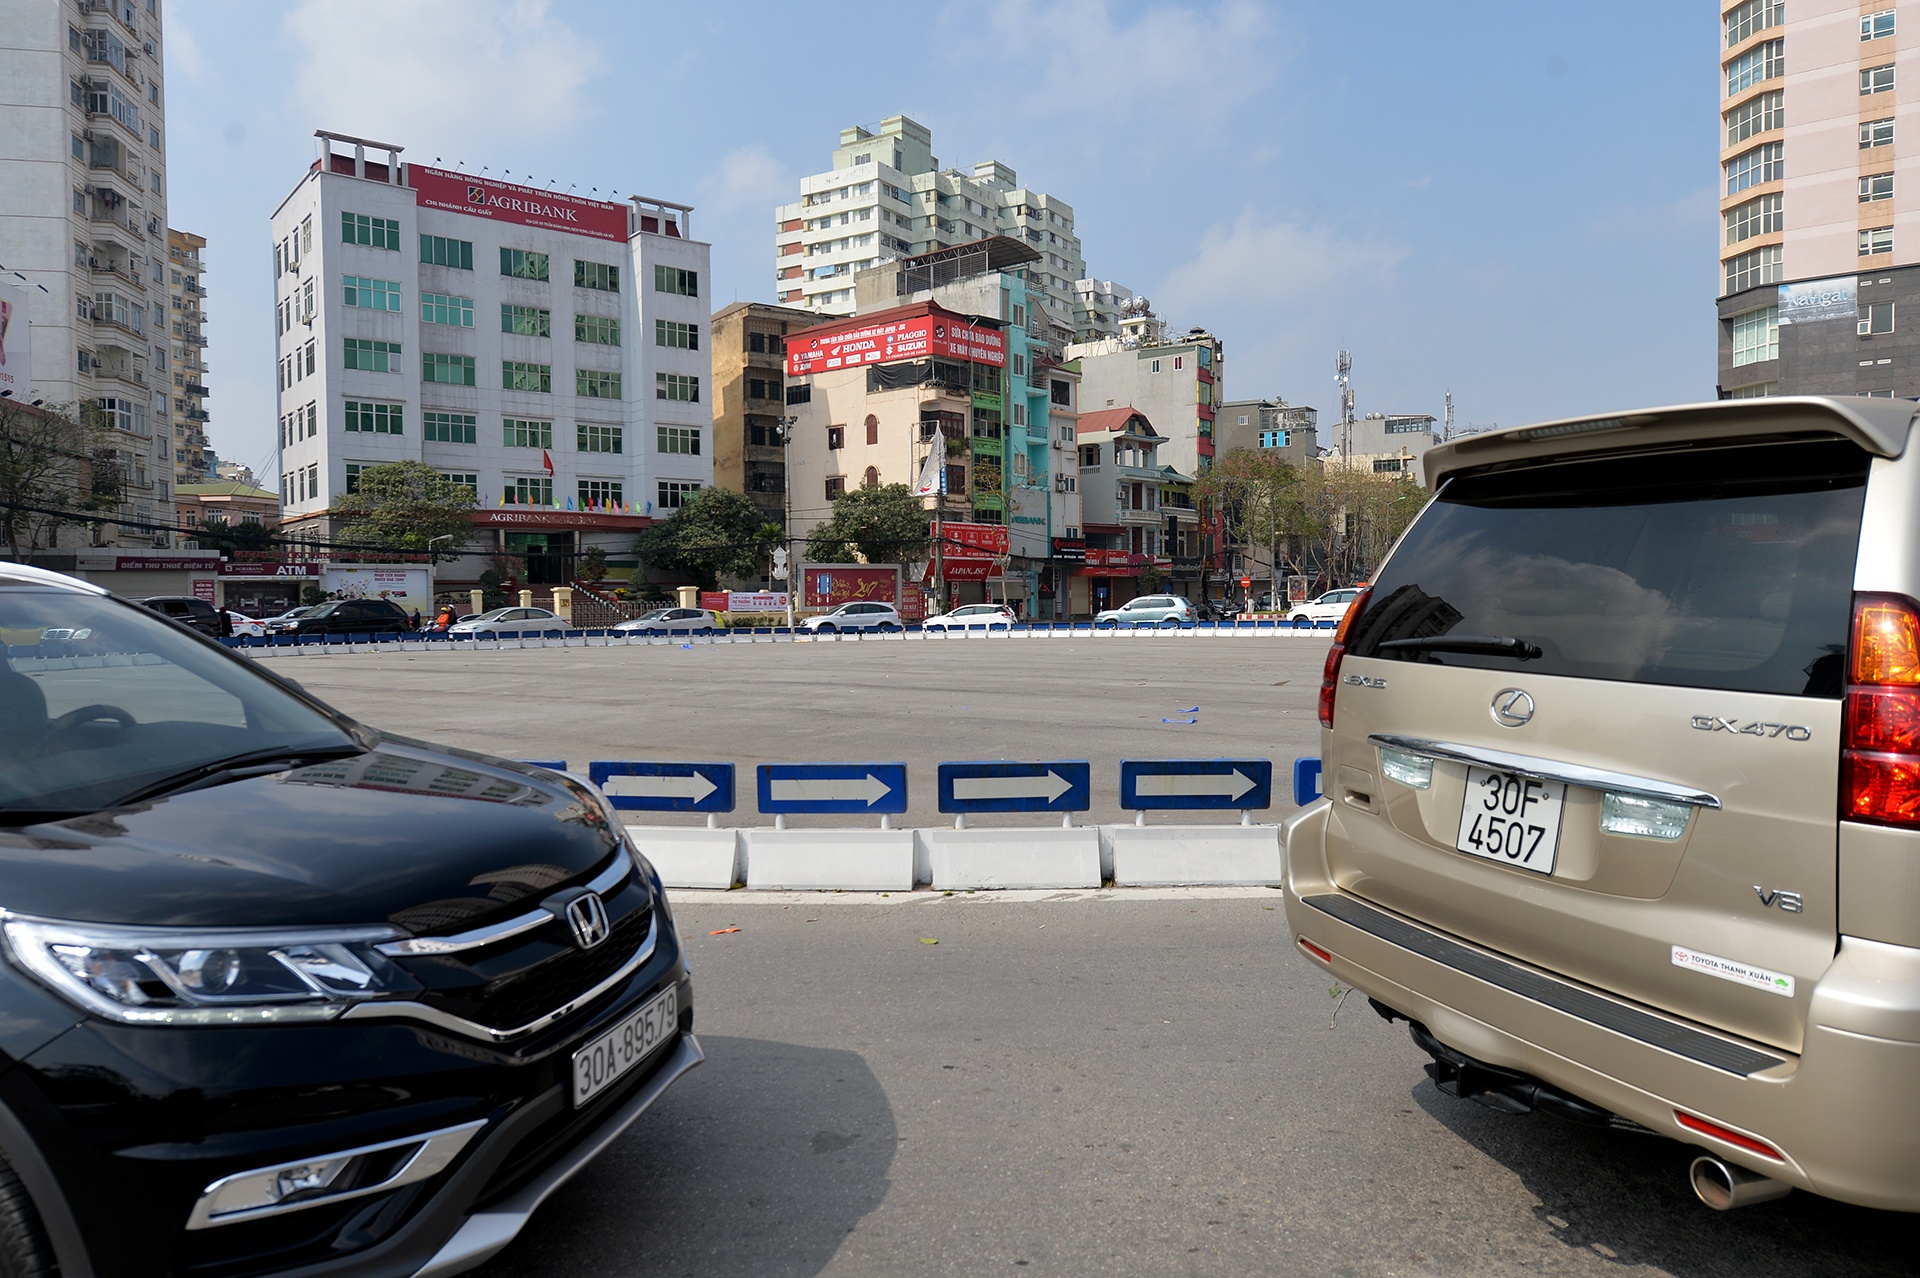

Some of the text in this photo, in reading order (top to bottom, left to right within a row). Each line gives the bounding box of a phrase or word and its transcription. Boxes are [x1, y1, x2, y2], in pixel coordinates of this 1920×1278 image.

[444, 172, 463, 181] HÀNG
[464, 176, 482, 184] NÔNG
[438, 201, 462, 210] NHÁNH
[487, 194, 578, 222] AGRIBANK
[897, 330, 927, 341] PIAGGIO
[842, 340, 876, 353] HONDA
[897, 340, 926, 352] SUZUKI
[950, 342, 956, 353] XE
[957, 343, 968, 355] MÁY
[801, 350, 824, 360] YAMAHA
[490, 513, 550, 523] AGRIBANK
[121, 561, 143, 569] ĐIỂM
[162, 561, 182, 569] THUẾ
[183, 562, 203, 570] ĐIỆN
[276, 565, 306, 575] ATM
[852, 578, 878, 598] 2017
[1484, 774, 1543, 818] 30F
[1468, 813, 1546, 863] 4507
[1753, 886, 1803, 913] V8
[1691, 956, 1718, 968] TOYOTA
[1720, 963, 1746, 975] THANH
[1749, 971, 1771, 982] XUÂN
